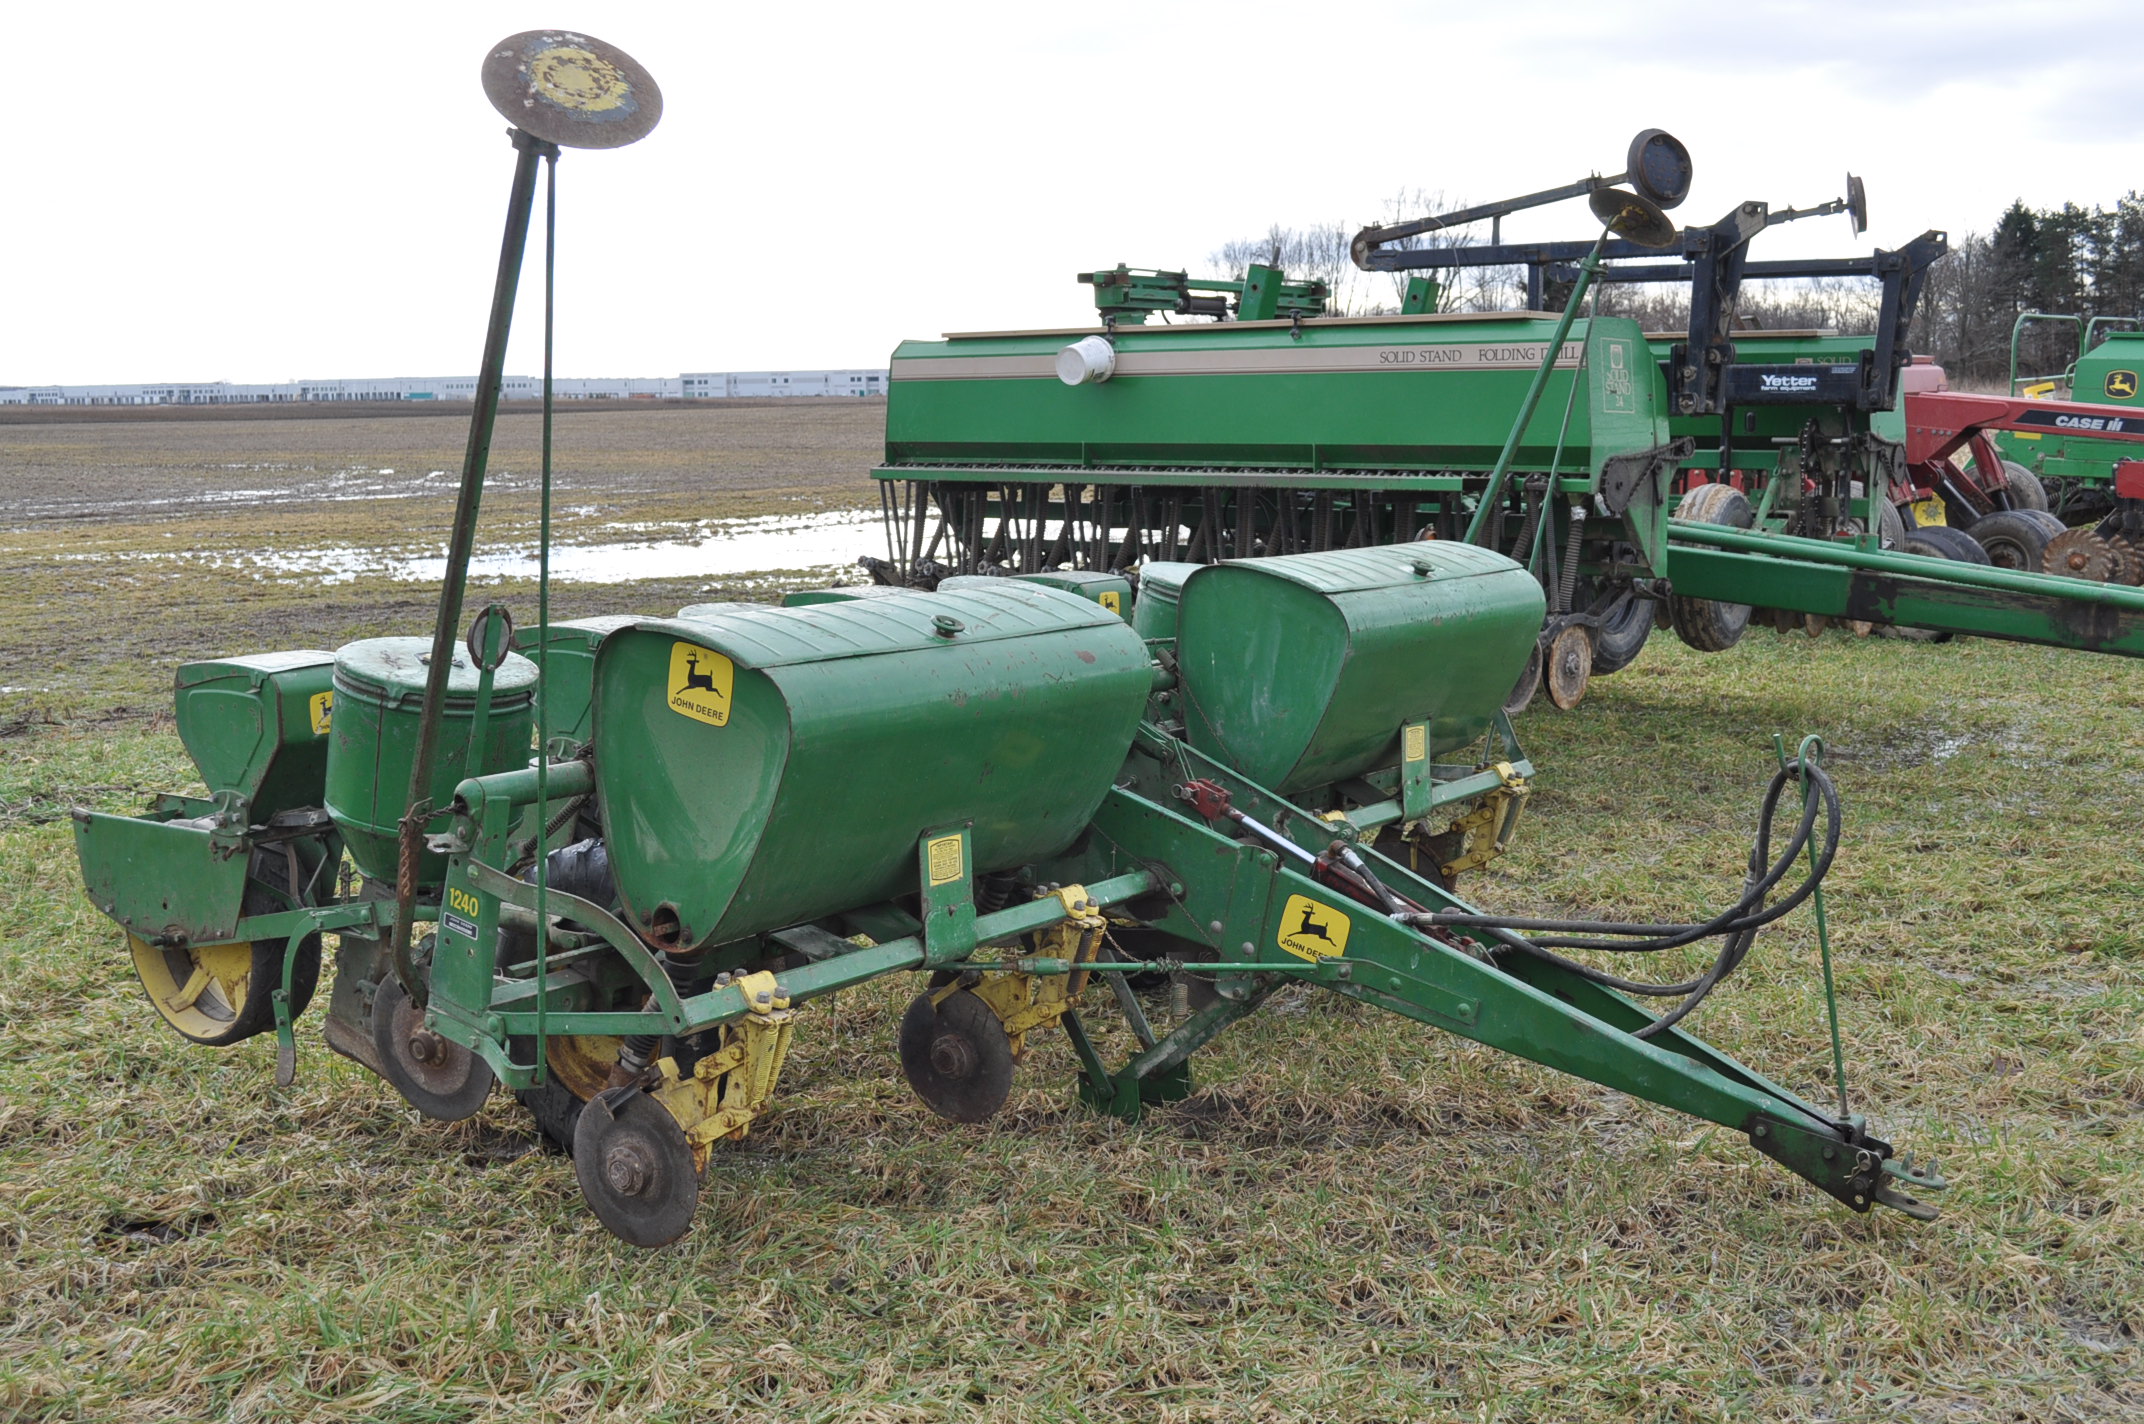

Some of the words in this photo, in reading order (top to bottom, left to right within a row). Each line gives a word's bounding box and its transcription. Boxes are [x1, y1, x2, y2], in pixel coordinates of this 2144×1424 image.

[1380, 351, 1415, 364] SOLID
[1420, 349, 1462, 363] STAND
[1478, 347, 1535, 361] FOLDING
[1540, 346, 1579, 360] DILL
[1606, 369, 1629, 382] SOLID
[1761, 374, 1817, 386] Yetter
[1606, 382, 1632, 395] STAND
[2055, 415, 2104, 430] CASE
[671, 696, 694, 711] JOHN
[696, 704, 724, 721] DEERE
[449, 887, 479, 917] 1240
[1281, 938, 1305, 952] JOHN
